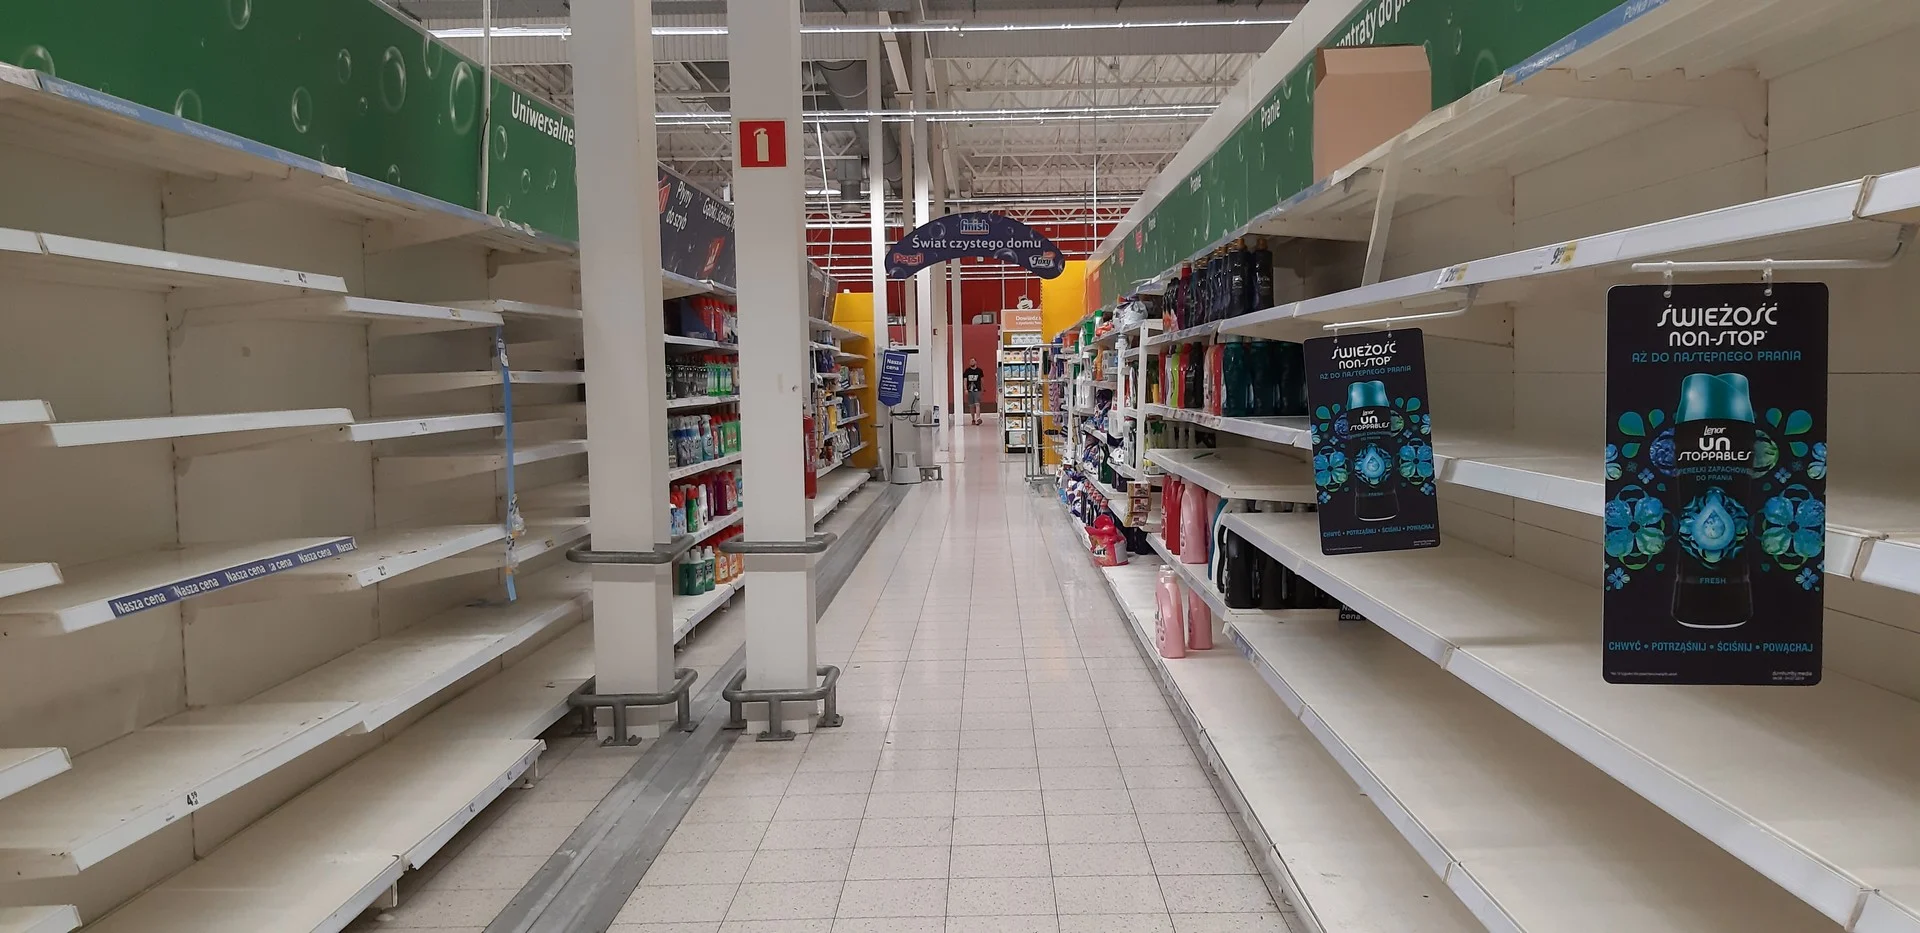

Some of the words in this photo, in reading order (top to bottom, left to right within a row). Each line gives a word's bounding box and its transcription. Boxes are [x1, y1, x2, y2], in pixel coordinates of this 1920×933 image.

[1336, 8, 1377, 46] ntraty
[1379, 0, 1393, 28] do
[511, 91, 574, 146] Uniwersalne
[1261, 95, 1281, 132] Pranie
[676, 181, 694, 208] Płyny
[666, 206, 674, 225] do
[673, 212, 688, 232] szyb
[960, 219, 989, 231] finish
[912, 236, 947, 249] Świat
[950, 238, 1004, 251] czystego
[1006, 237, 1042, 249] domu
[893, 253, 924, 266] Persil
[1031, 255, 1052, 268] Foxy
[1656, 302, 1778, 327] ŚWIEŻOŚĆ
[1331, 340, 1397, 360] ŚWIEŻOŚĆ
[1632, 351, 1647, 363] AŻ
[1652, 352, 1670, 363] DO
[1673, 351, 1754, 363] NASTĘPNEGO
[1757, 350, 1802, 361] PRANIA
[1319, 372, 1329, 380] AŻ
[1342, 368, 1386, 378] NASTĘPNEGO
[1387, 365, 1412, 374] PRANIA
[1349, 422, 1390, 431] STOPPABLES
[1703, 425, 1727, 436] Lenor
[1677, 451, 1752, 461] STOPPABLES
[336, 542, 353, 553] Nasza
[276, 558, 293, 569] cena
[298, 552, 318, 564] Nasza
[317, 548, 332, 559] cena
[225, 568, 249, 583] Nasza
[248, 564, 266, 577] cena
[173, 583, 200, 598] Nasza
[199, 578, 220, 591] cena
[115, 601, 144, 615] Nasza
[143, 592, 167, 606] cena
[1608, 640, 1641, 650] CHWYĆ
[1651, 641, 1707, 653] POTRZĄŚNIJ
[1717, 640, 1753, 652] ŚCIŚNIJ
[1762, 642, 1814, 654] POWĄCHAJ
